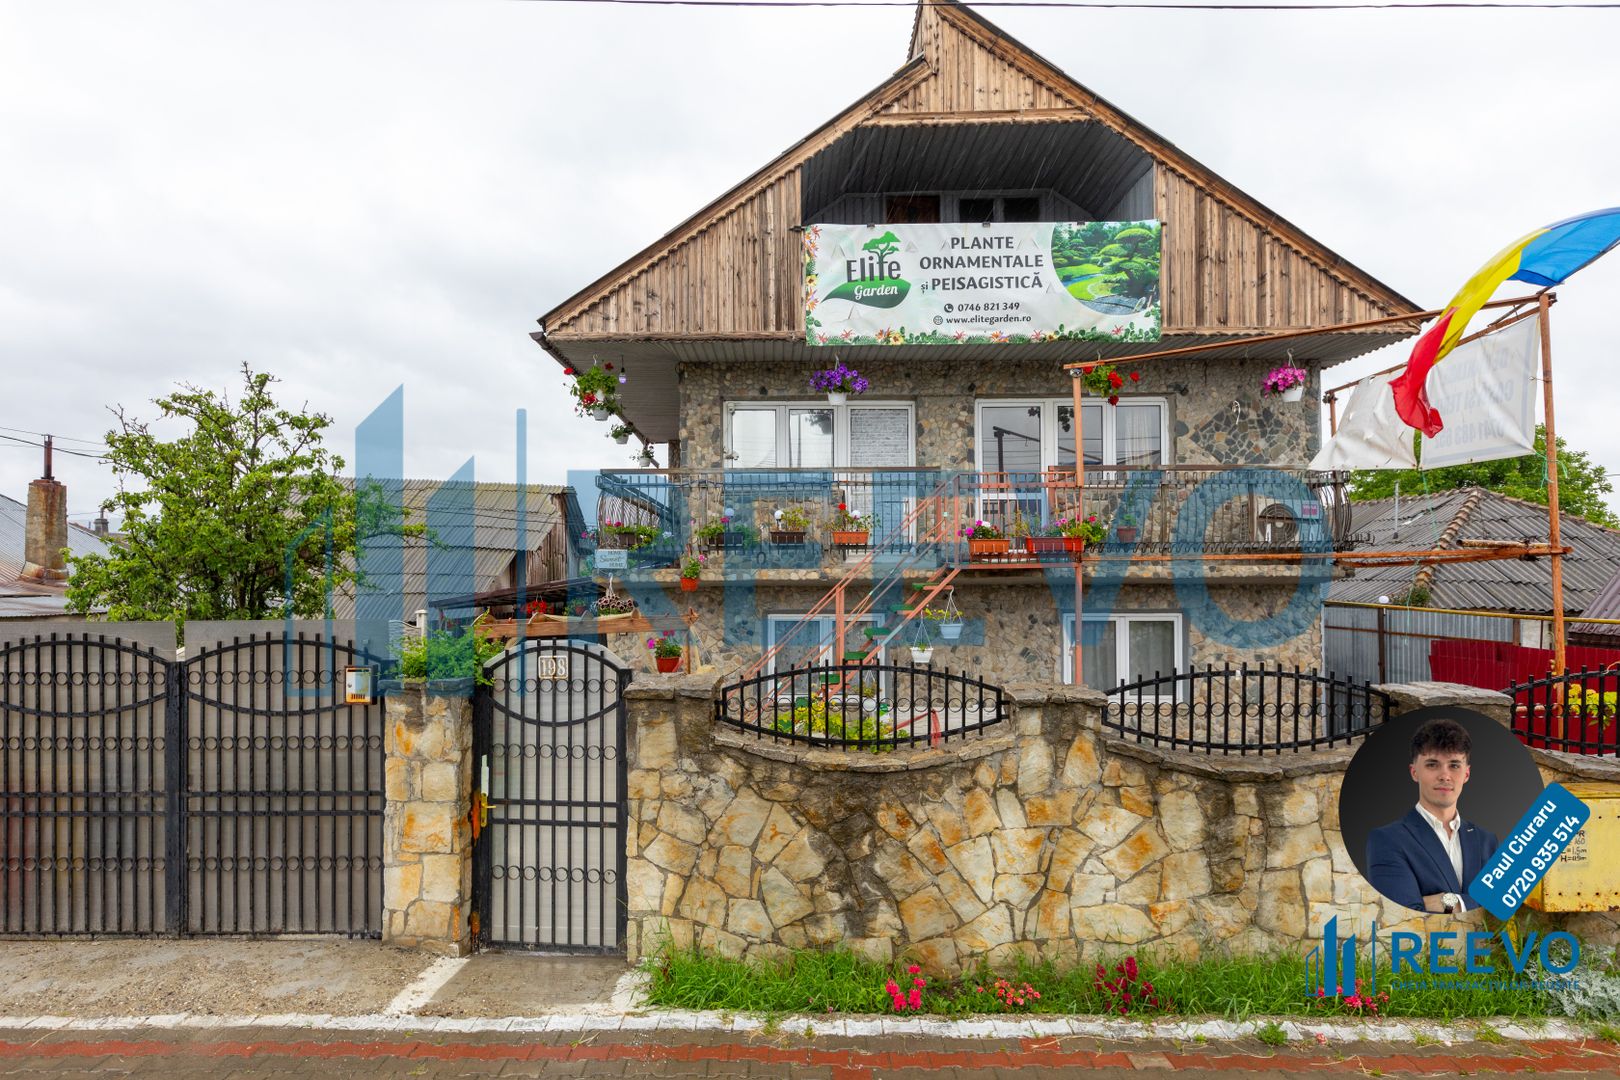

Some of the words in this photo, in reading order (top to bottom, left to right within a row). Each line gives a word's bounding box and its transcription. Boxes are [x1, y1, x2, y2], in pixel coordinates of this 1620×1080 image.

[951, 236, 1014, 250] PLANTE
[846, 256, 901, 282] Elite
[919, 254, 1044, 270] ORNAMENTALE
[920, 281, 928, 294] și
[931, 272, 1043, 291] PEISAGISTICĂ
[853, 284, 899, 300] Garden
[957, 303, 981, 312] 0746
[983, 302, 1000, 311] 821
[1002, 302, 1020, 310] 349
[946, 314, 1032, 325] www.elitegarden.ro
[541, 658, 566, 676] 198
